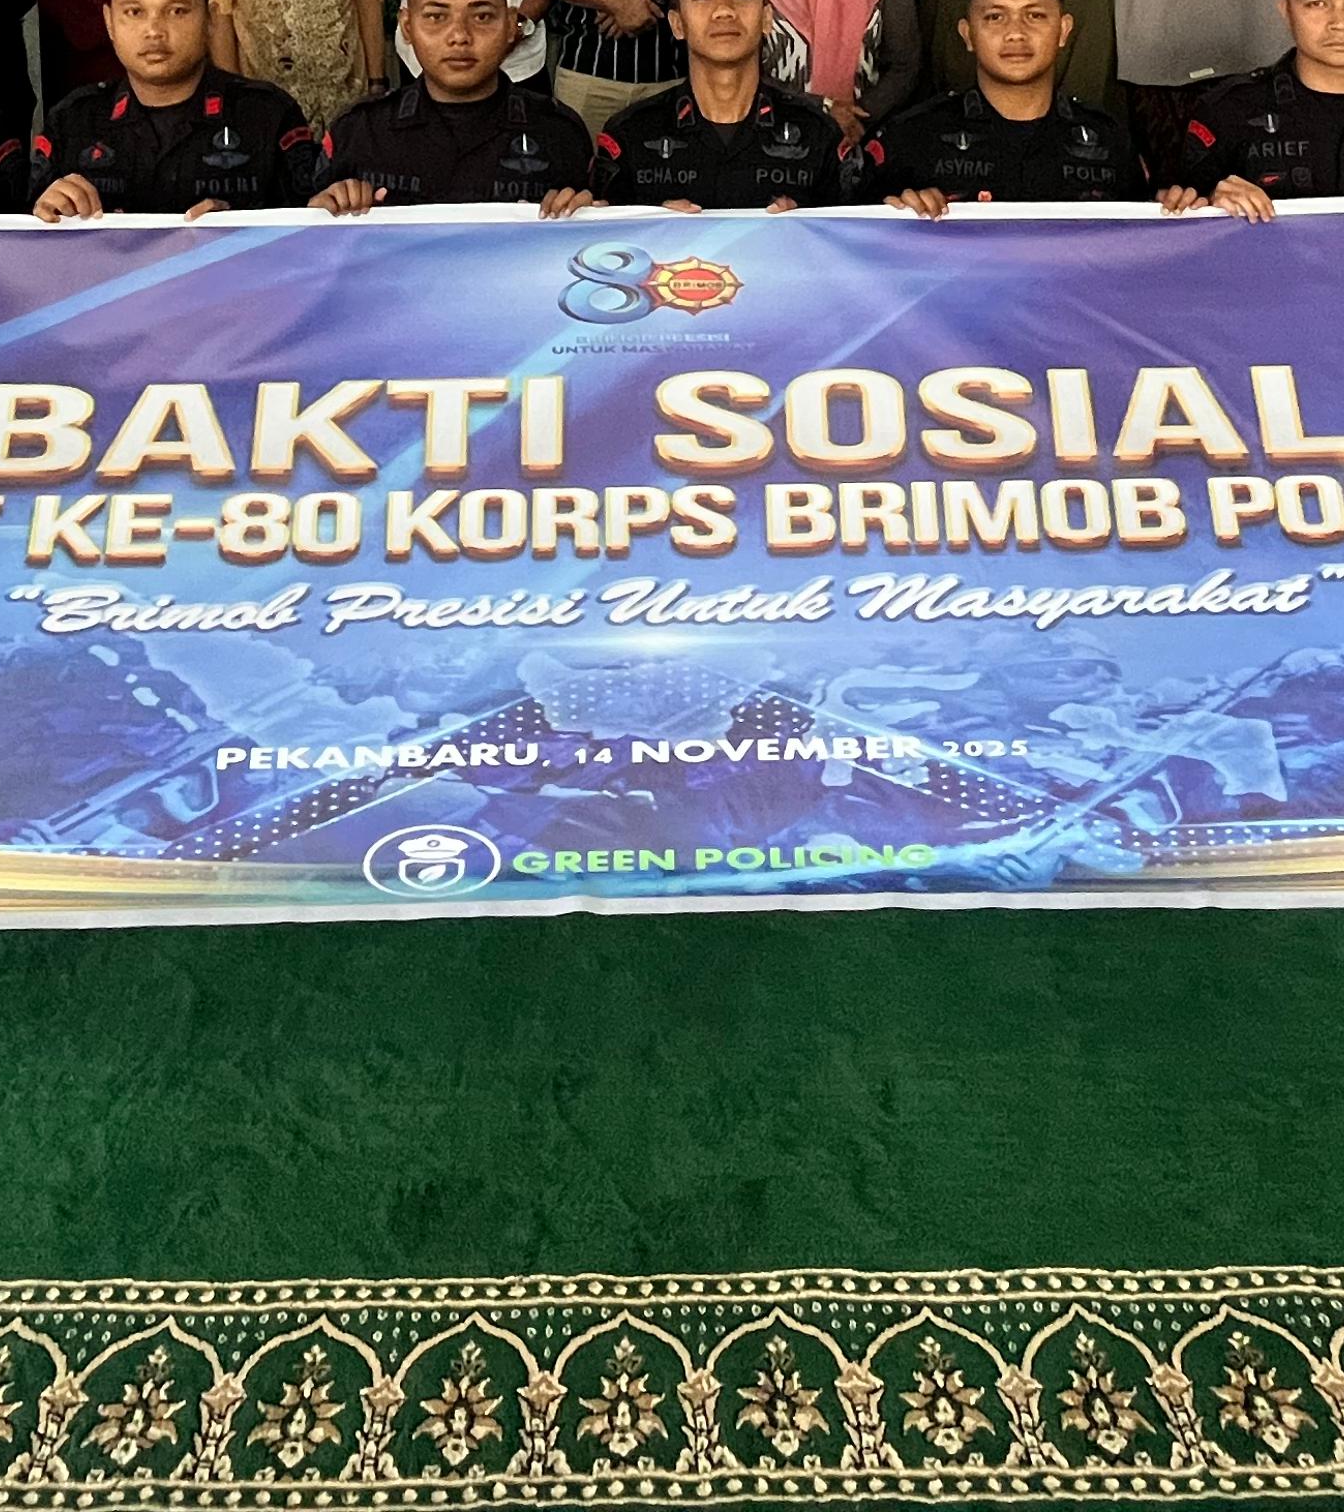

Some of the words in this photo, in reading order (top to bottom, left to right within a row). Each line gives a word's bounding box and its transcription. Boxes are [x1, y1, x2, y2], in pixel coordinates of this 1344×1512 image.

[1247, 140, 1311, 159] ARIEF
[756, 168, 813, 187] POLRI
[934, 158, 995, 177] ASYRAF
[194, 175, 258, 196] POLRI
[552, 345, 617, 355] UNTUK
[25, 486, 365, 568] KE-80
[383, 482, 738, 565] KORPS
[762, 476, 1191, 556] BRIMOB
[329, 579, 586, 633] Presisi
[598, 569, 835, 626] Untuk
[573, 748, 615, 767] 14
[629, 736, 924, 765] NOVEMBER
[941, 739, 1030, 758] 2025
[512, 846, 677, 876] GREEN
[694, 841, 936, 872] POLICING
